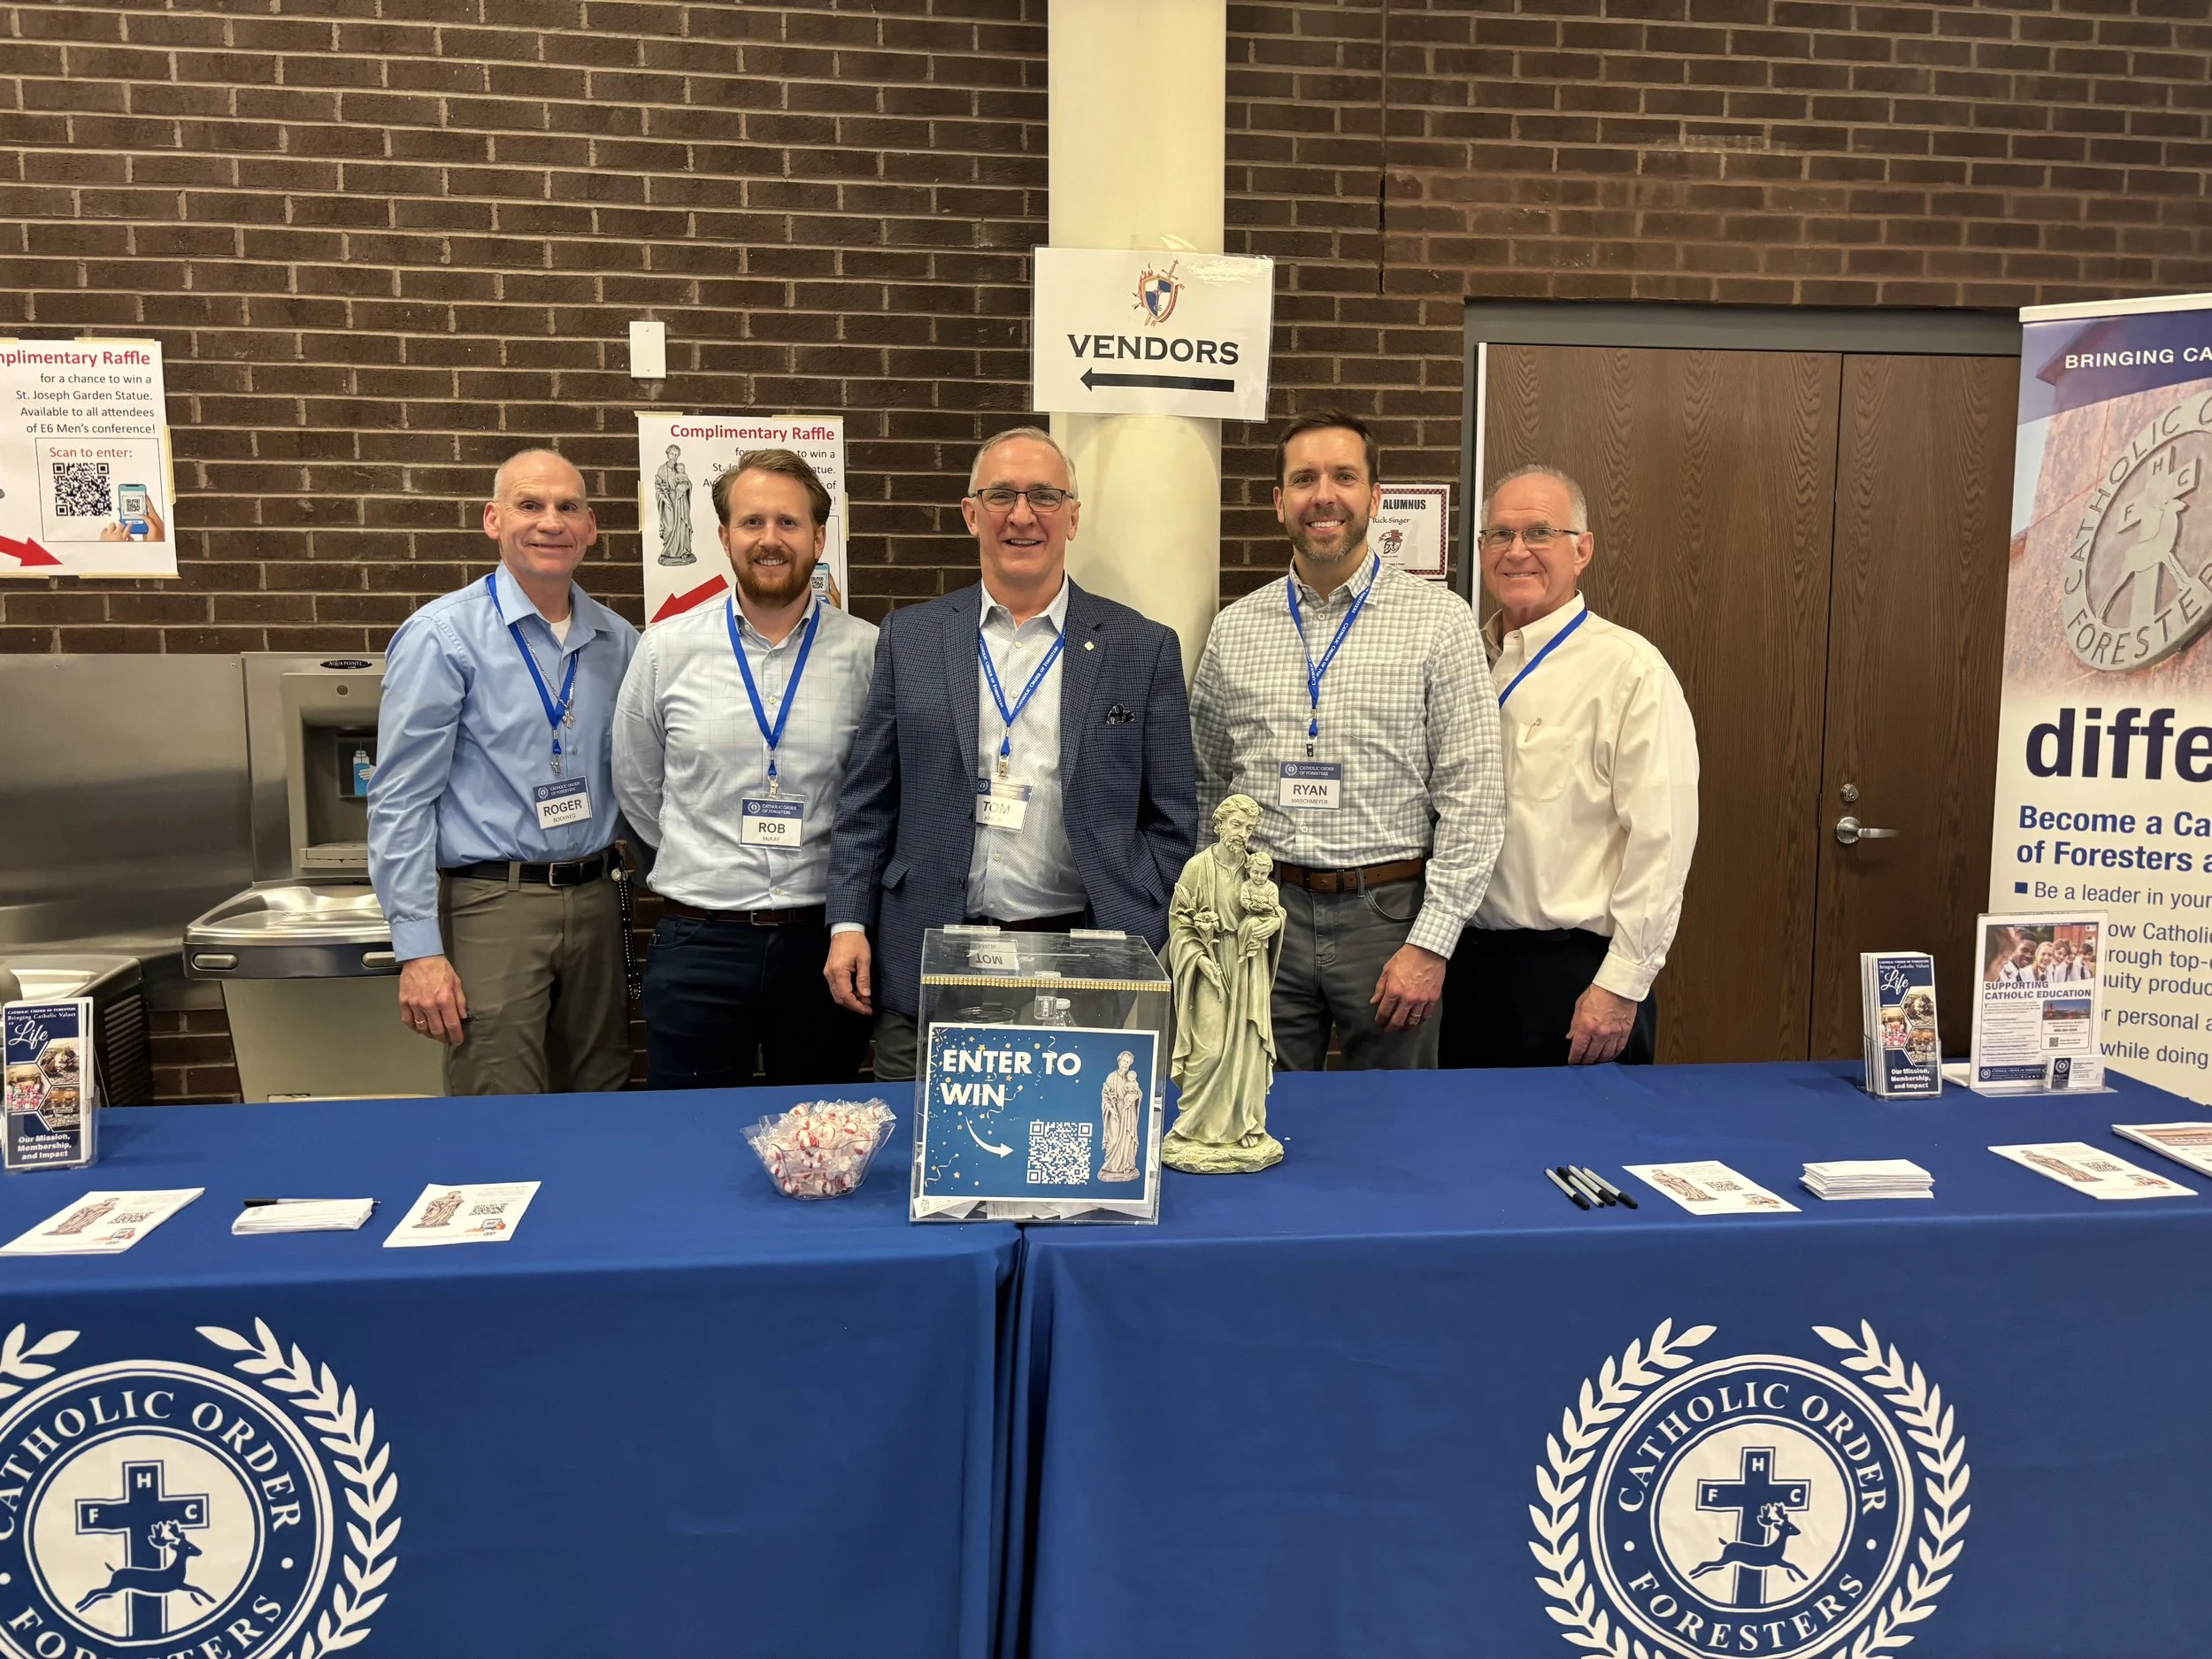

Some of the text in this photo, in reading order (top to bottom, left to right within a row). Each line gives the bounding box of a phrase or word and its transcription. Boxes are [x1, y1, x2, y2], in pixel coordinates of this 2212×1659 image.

[1066, 334, 1240, 365] VENDORS
[103, 350, 150, 365] Raffle
[2065, 349, 2174, 369] BRINGING
[41, 373, 56, 384] for
[67, 373, 106, 384] chance
[109, 375, 120, 384] to
[122, 374, 142, 384] win
[16, 390, 153, 403] St. Joseph Garden Statue.
[20, 407, 154, 418] Available to all attendees
[26, 423, 156, 434] of E6 Men's conference!
[670, 425, 835, 442] Complimentary Raffle
[50, 447, 133, 458] Scan to enter:
[810, 449, 827, 457] win
[712, 463, 726, 472] St.
[826, 480, 836, 489] of
[1382, 499, 1426, 510] ALUMNUS
[2064, 405, 2182, 595] CATHOLIC
[1293, 784, 1327, 796] RYAN
[543, 799, 582, 817] ROGER
[983, 801, 1010, 814] TOM
[2019, 805, 2136, 833] Become
[2146, 816, 2162, 834] a
[758, 822, 786, 833] ROB
[2016, 840, 2046, 864] of
[2055, 841, 2193, 872] Foresters
[2034, 881, 2212, 910] Be a leader in your
[2108, 923, 2137, 938] ow
[2105, 949, 2212, 972] rough top-
[1880, 969, 1909, 995] Life
[1985, 980, 2049, 990] SUPPORTING
[1985, 988, 2092, 1000] CATHOLIC EDUCATION
[2117, 1010, 2199, 1030] personal
[8, 1019, 49, 1050] Life
[942, 1049, 1081, 1076] ENTER TO
[2100, 1041, 2208, 1070] while doing
[940, 1082, 1006, 1107] WIN
[35, 1133, 71, 1142] Mission,
[18, 1141, 72, 1152] Membership,
[39, 1150, 68, 1159] Impact
[1618, 1381, 1887, 1516] CATHOLIC ORDER
[0, 1390, 302, 1541] CATHOLIC ORDER
[1752, 1458, 1763, 1471] H
[137, 1473, 152, 1488] H
[1709, 1488, 1801, 1502] F C
[89, 1504, 198, 1524] F C
[1627, 1569, 1863, 1652] FORESTERS
